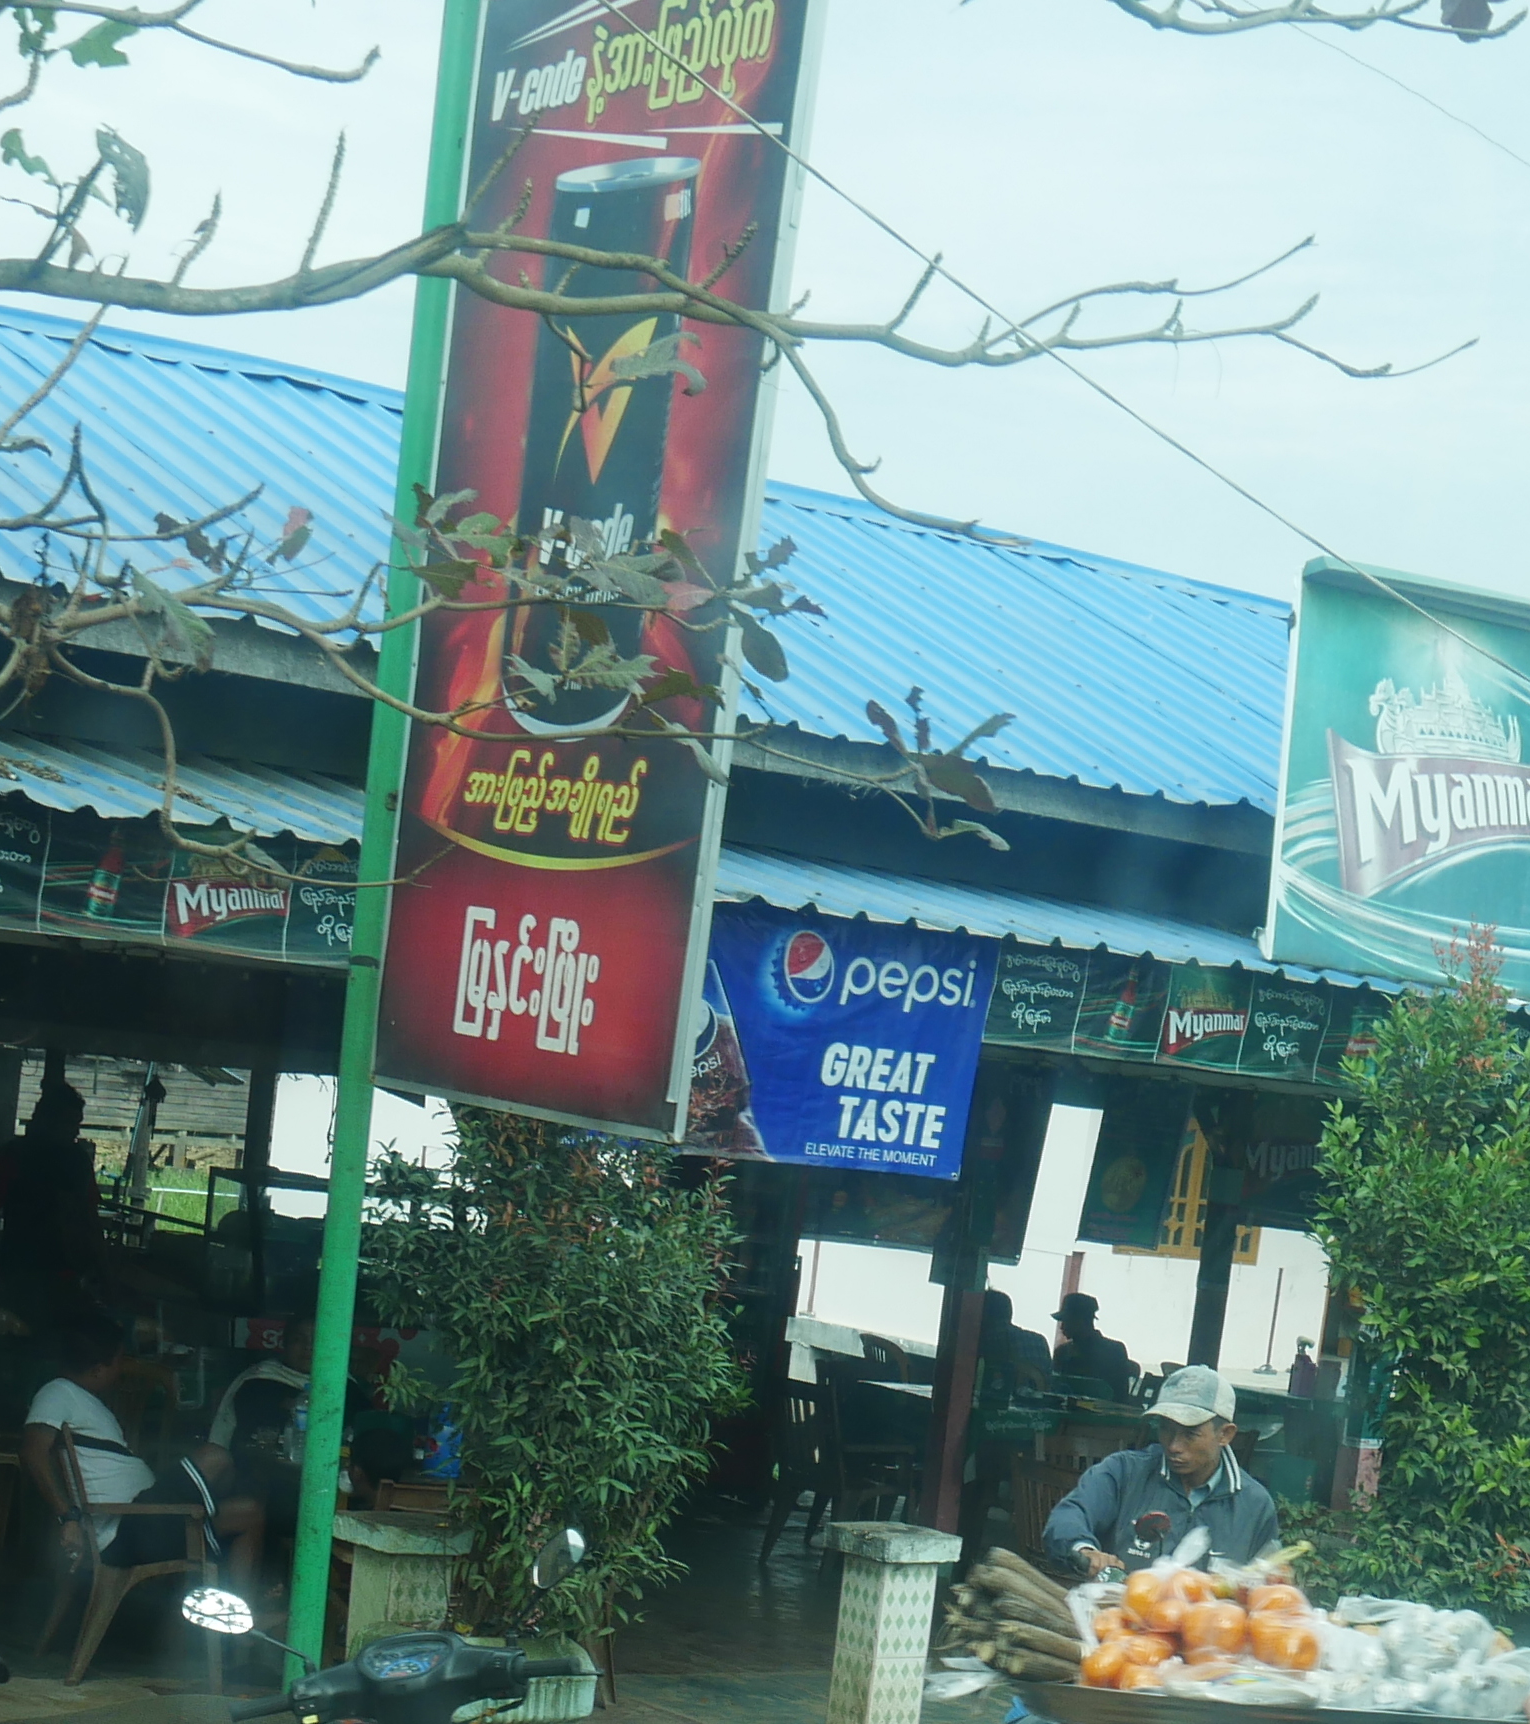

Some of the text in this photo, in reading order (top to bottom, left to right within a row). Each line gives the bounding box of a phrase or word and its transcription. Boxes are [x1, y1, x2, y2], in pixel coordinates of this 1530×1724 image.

[840, 957, 977, 1013] pepsi
[1169, 1010, 1245, 1044] Myanmar
[689, 1051, 723, 1078] epsi
[821, 1042, 936, 1095] GREAT
[838, 1096, 947, 1149] TASTE
[805, 1142, 937, 1168] ELEVATE THE MOMENT
